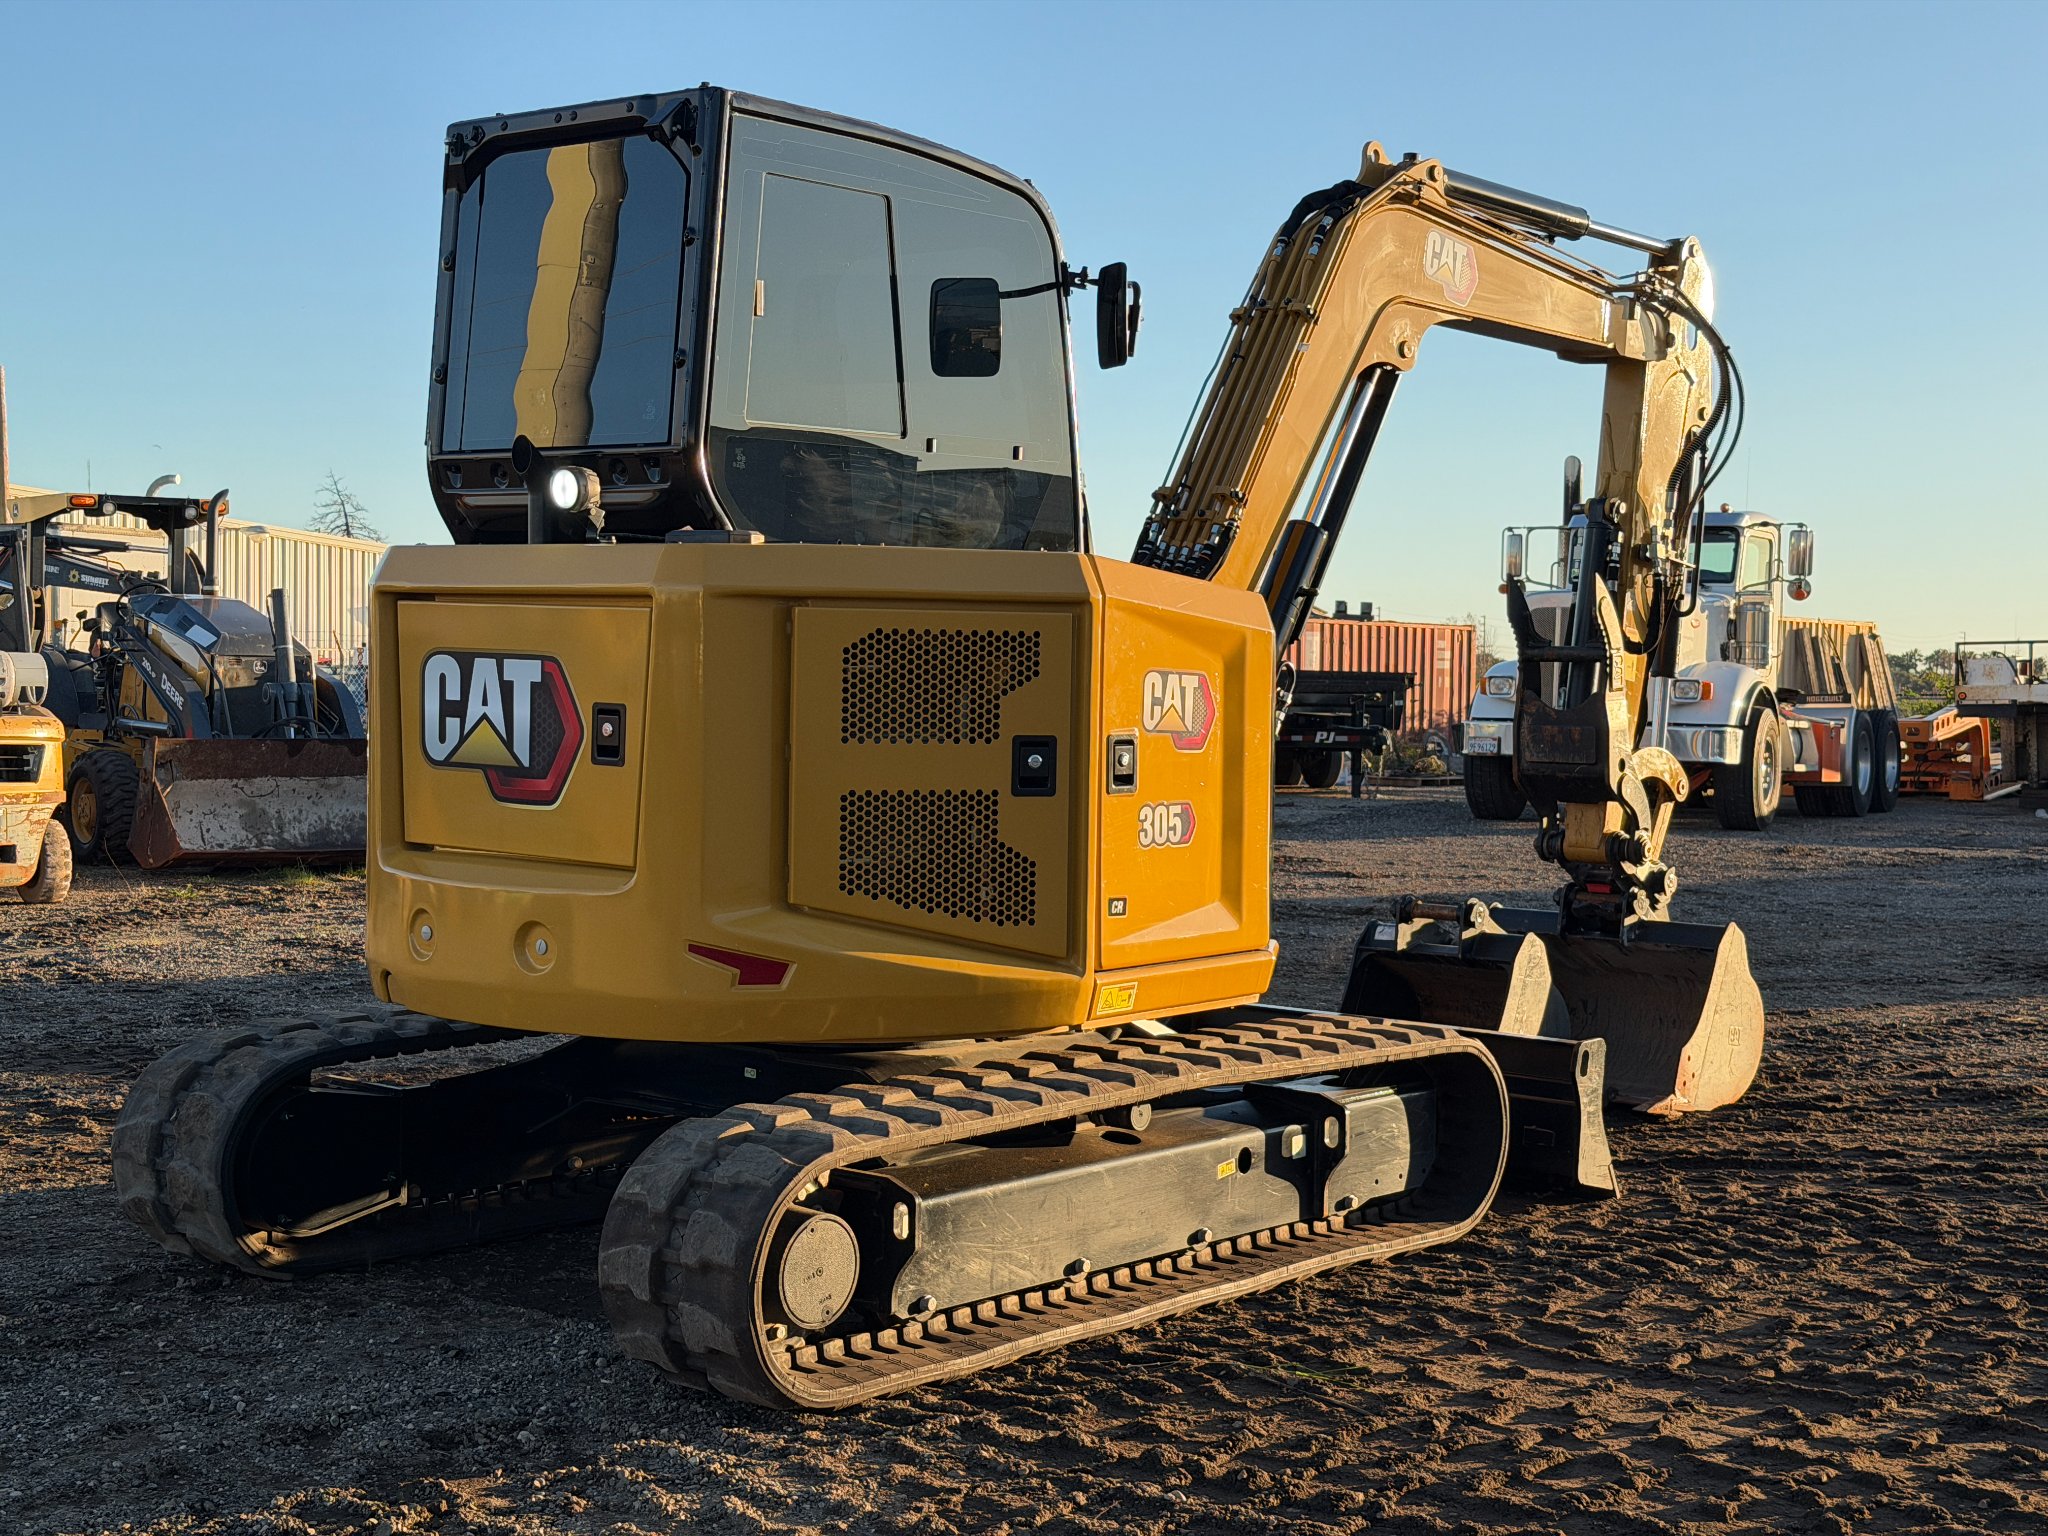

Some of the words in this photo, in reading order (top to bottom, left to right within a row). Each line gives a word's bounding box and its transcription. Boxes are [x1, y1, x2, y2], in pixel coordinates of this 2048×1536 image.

[1425, 231, 1467, 288] CAT
[80, 574, 109, 585] SUNBELT
[161, 672, 184, 711] DEERE
[424, 654, 541, 768] CAT
[1143, 671, 1199, 732] CAT
[1314, 731, 1336, 744] PJ
[1139, 804, 1182, 846] 305
[1111, 900, 1125, 914] CR
